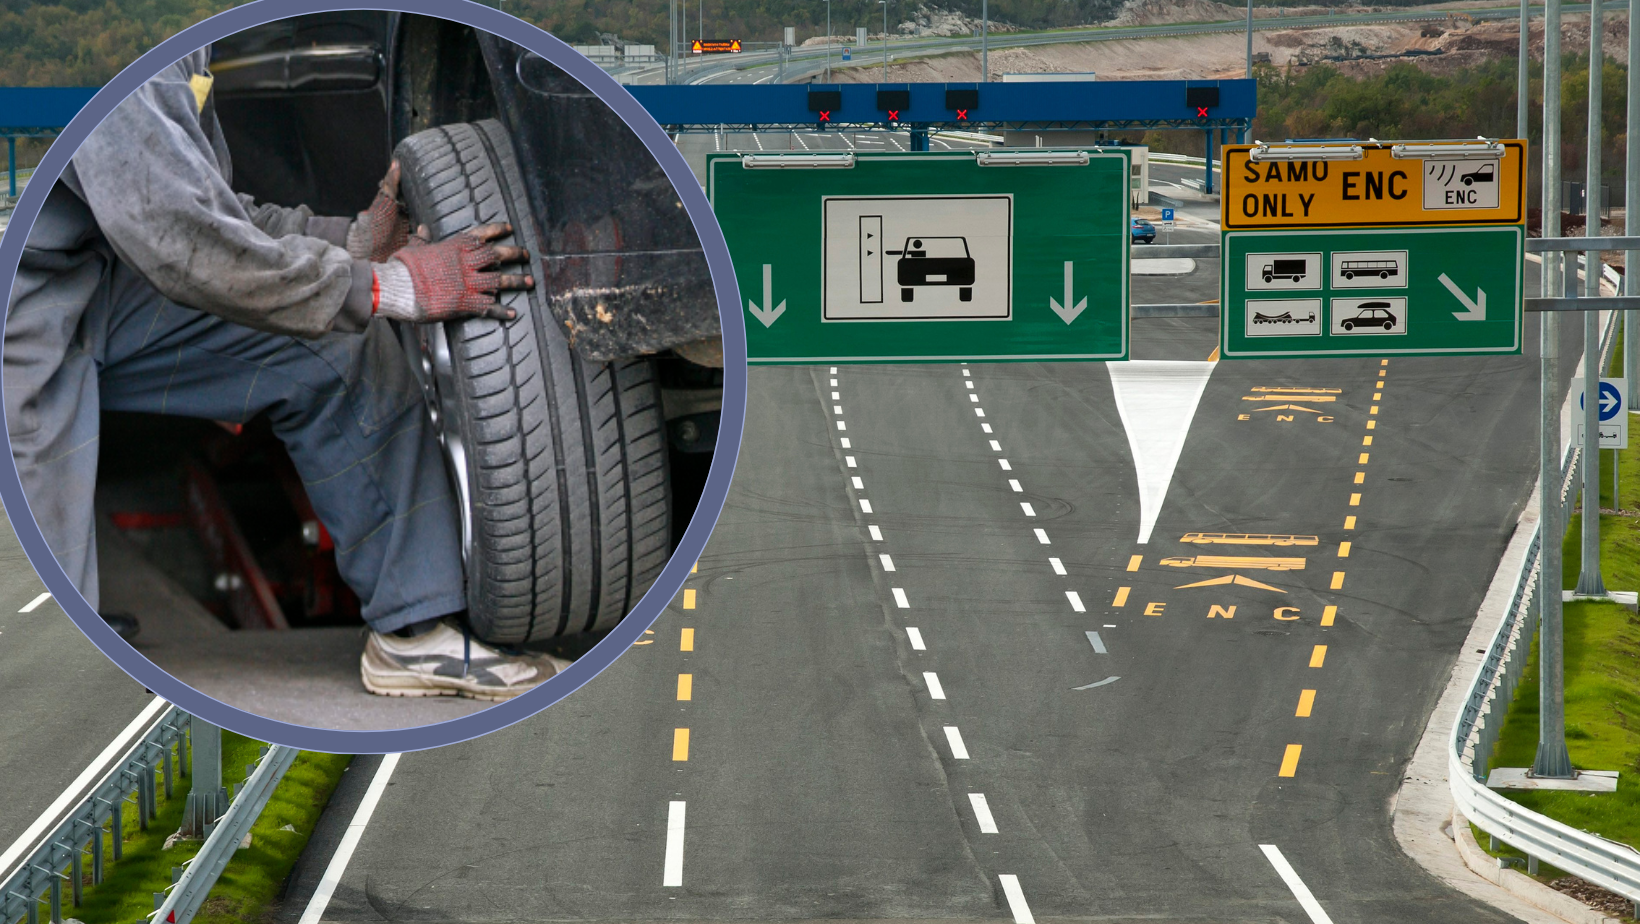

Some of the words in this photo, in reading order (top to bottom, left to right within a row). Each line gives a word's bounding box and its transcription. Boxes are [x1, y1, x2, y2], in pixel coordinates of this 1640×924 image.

[1244, 159, 1328, 183] SAMO
[1342, 170, 1408, 201] ENC
[1242, 193, 1315, 218] ONLY
[1444, 189, 1477, 205] ENC
[1237, 414, 1334, 423] ENC
[1143, 602, 1301, 621] ENC
